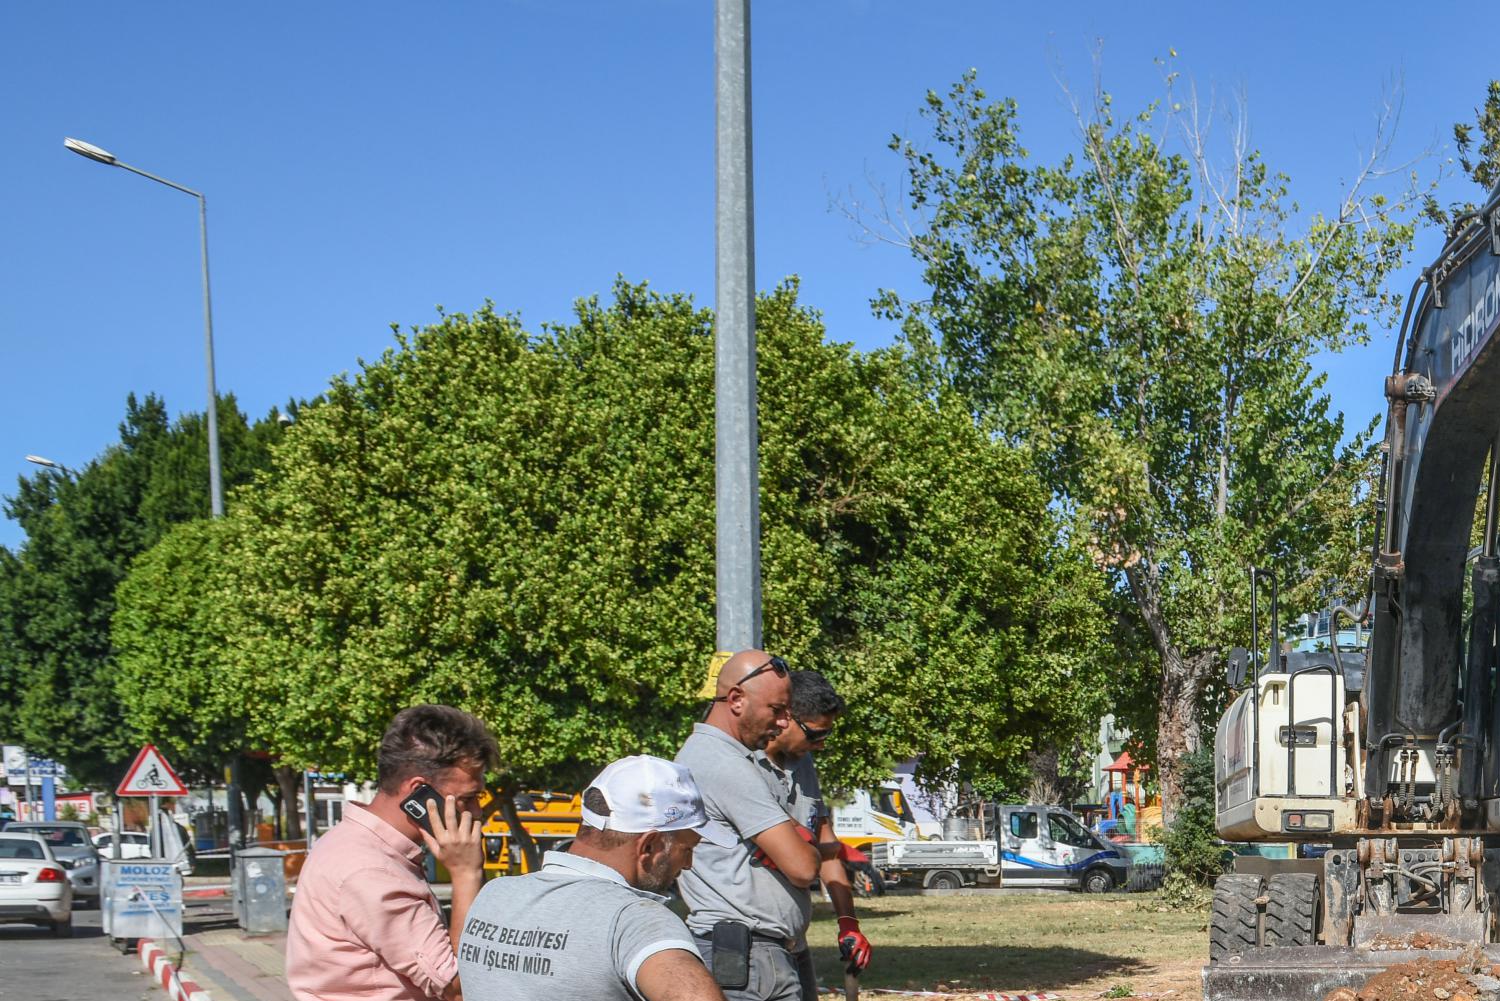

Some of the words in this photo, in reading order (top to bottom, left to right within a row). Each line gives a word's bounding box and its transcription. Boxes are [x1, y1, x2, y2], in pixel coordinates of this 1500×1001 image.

[121, 865, 170, 876] MOLOZ
[498, 926, 570, 951] BELEDİYESİ
[461, 943, 481, 964] FEN
[483, 945, 520, 971] İŞLERİ
[522, 953, 554, 977] MÜD.
